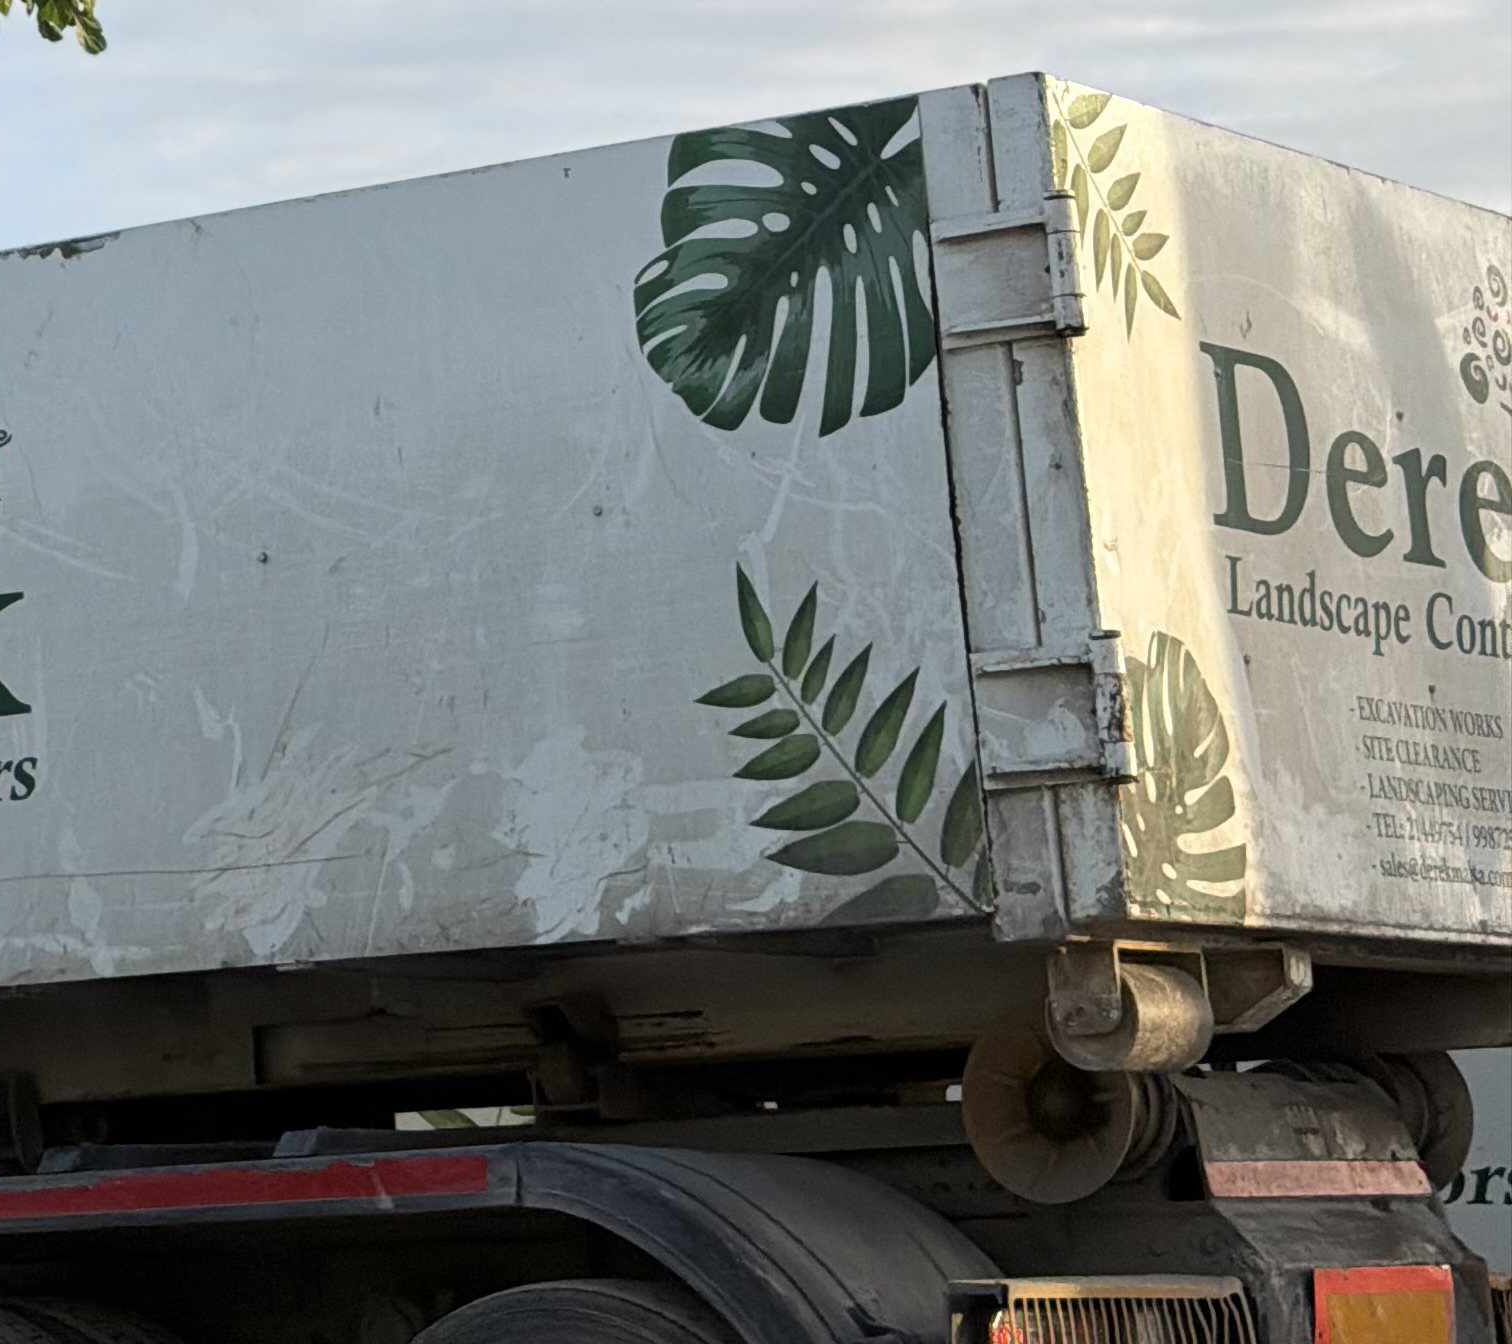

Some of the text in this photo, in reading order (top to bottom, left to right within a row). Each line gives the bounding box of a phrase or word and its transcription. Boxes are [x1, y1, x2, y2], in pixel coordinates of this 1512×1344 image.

[1199, 340, 1512, 583] Dere
[1225, 554, 1411, 657] Landscape
[1356, 695, 1504, 739] EXCAVATION WORKS
[1362, 735, 1482, 774] SITE CLEARANCE
[1367, 773, 1470, 810] LANDSCAPING
